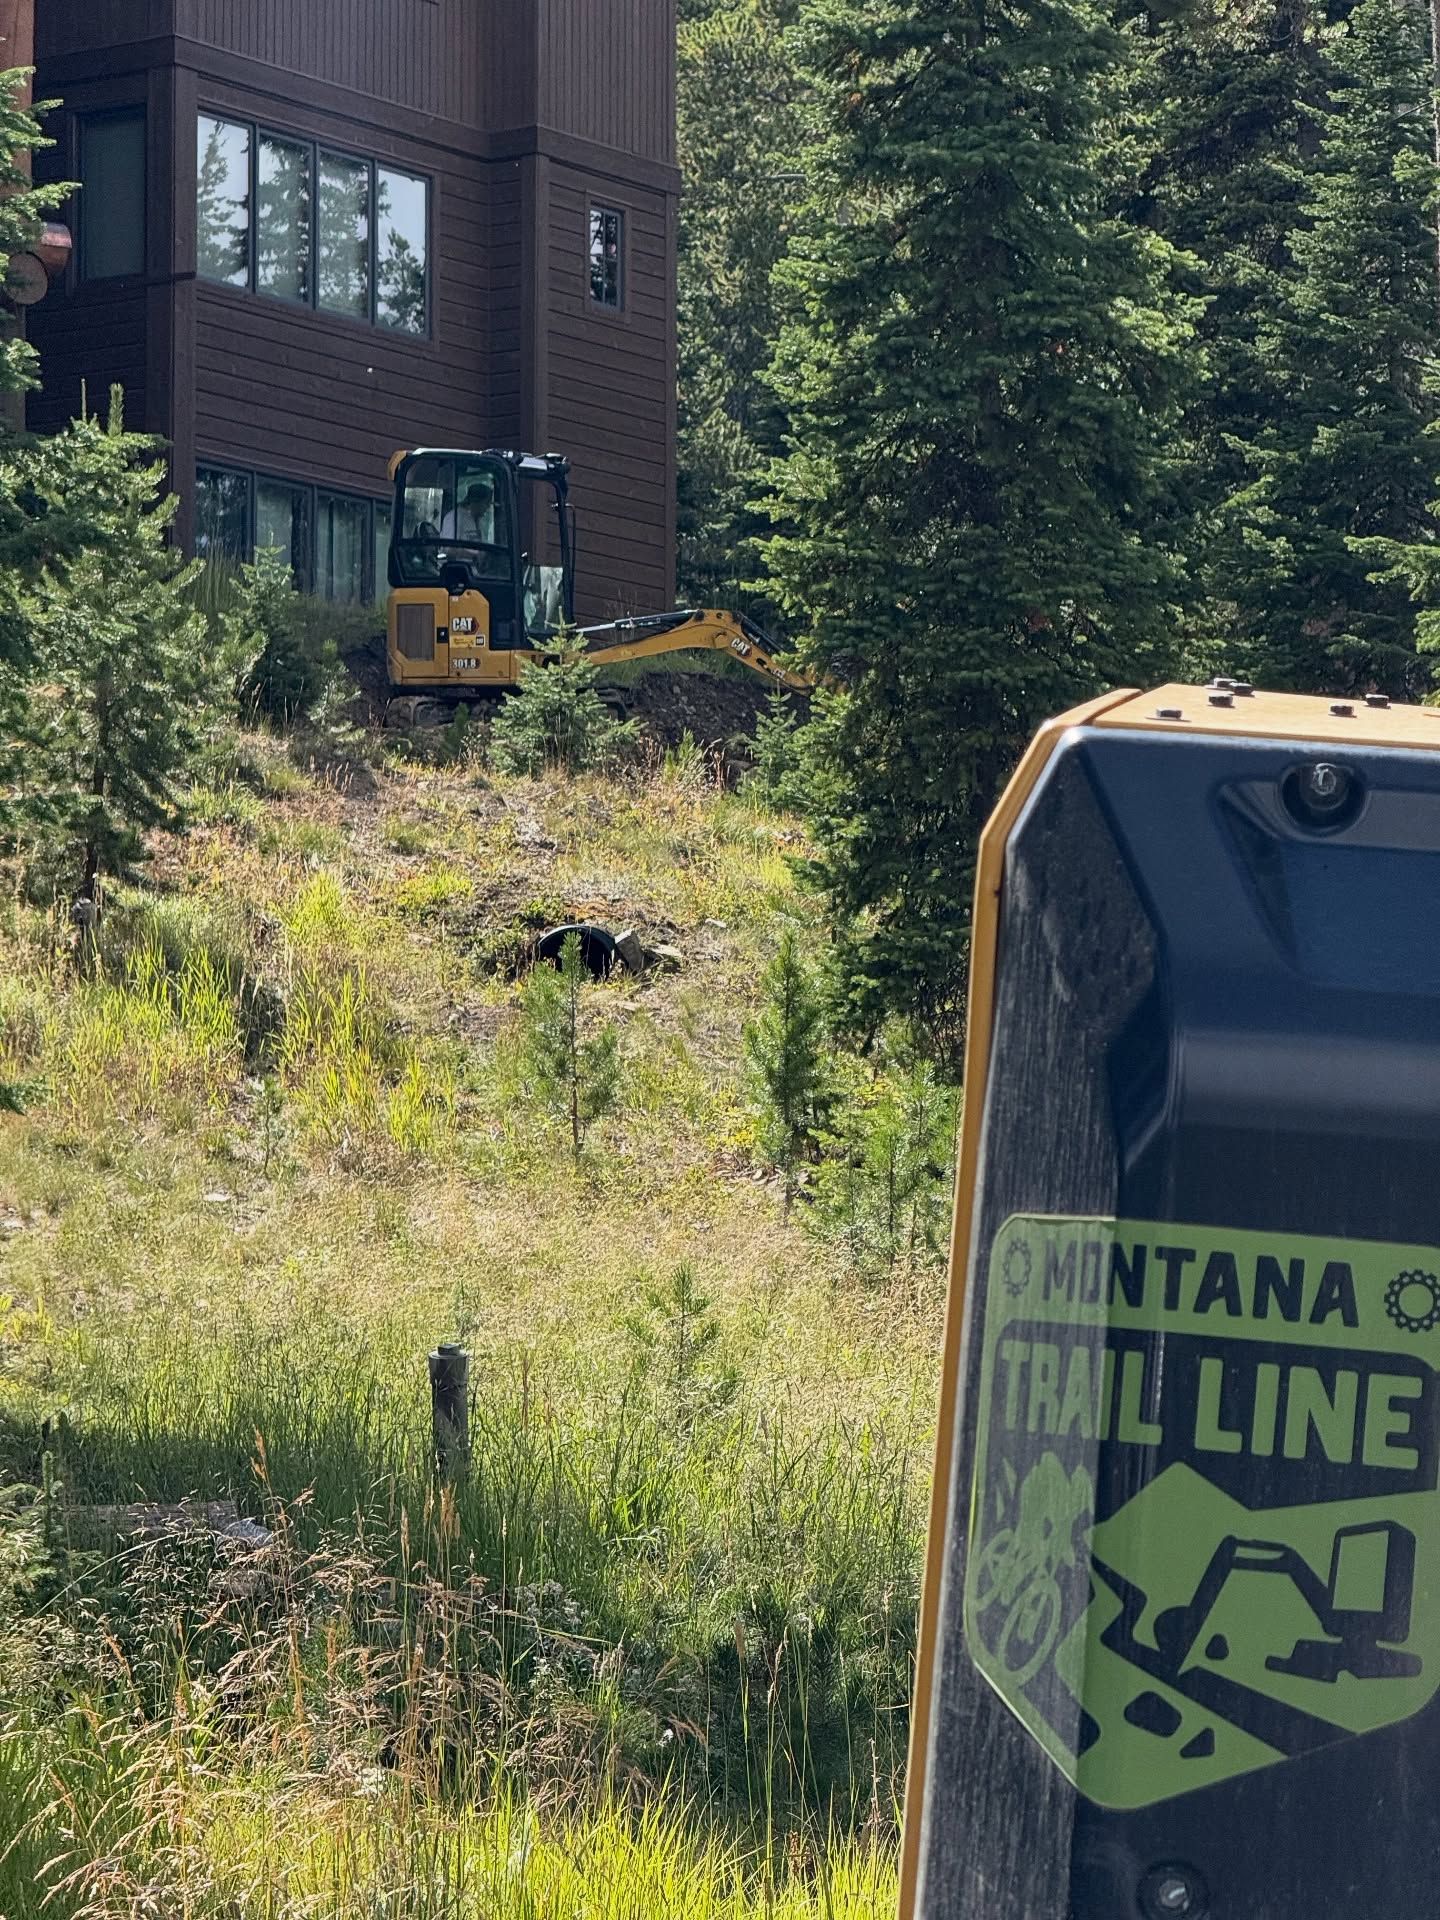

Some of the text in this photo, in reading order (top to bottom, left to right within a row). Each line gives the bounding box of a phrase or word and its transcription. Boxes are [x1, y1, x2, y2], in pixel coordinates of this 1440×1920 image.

[453, 617, 473, 631] CAT
[731, 638, 750, 655] CAT
[1042, 1238, 1360, 1327] MONTANA
[1000, 1338, 1423, 1470] TRAIL LINE
